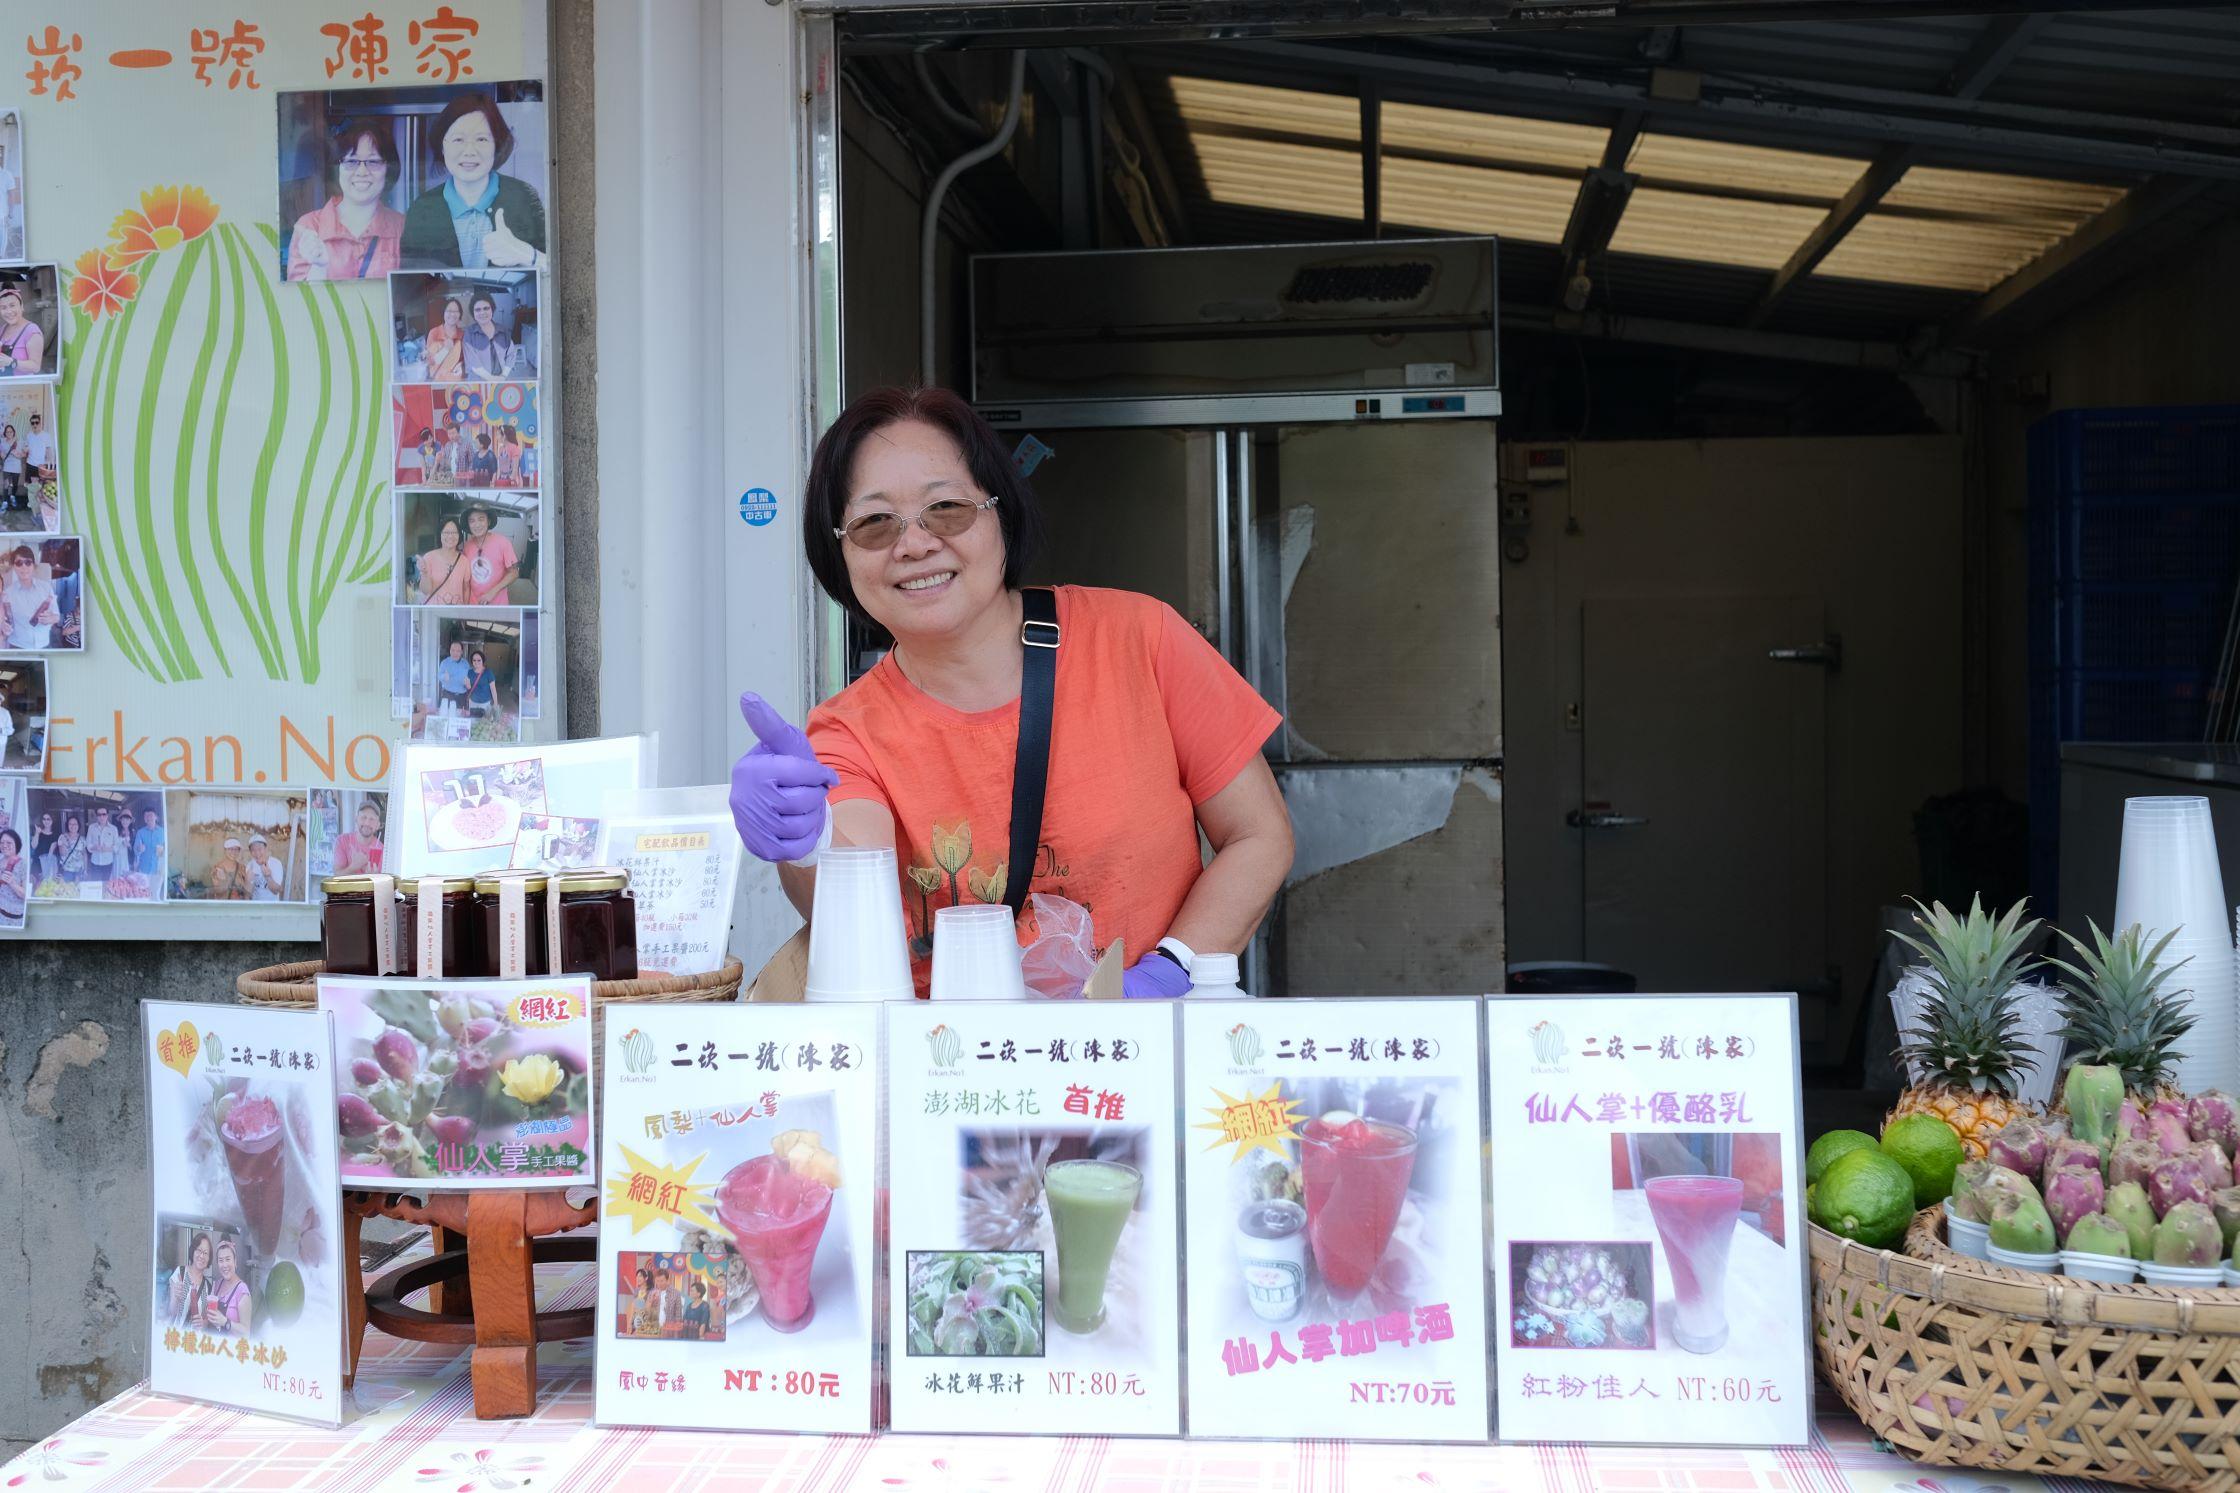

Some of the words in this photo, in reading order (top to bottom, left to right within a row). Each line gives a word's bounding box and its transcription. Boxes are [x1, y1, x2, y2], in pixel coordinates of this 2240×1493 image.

[320, 6, 479, 84] 陳家
[44, 709, 408, 784] Erkan.No
[520, 996, 570, 1022] 網紅
[160, 1033, 196, 1062] 首推
[924, 1087, 1041, 1116] 澎湖冰花
[1062, 1083, 1126, 1121] 首推
[1524, 1090, 1754, 1125] 仙人掌+優酪乳
[1221, 1097, 1294, 1143] 網紅
[434, 1141, 530, 1173] 仙人掌
[530, 1154, 579, 1168] 手工果醬
[625, 1171, 690, 1215] 網紅
[1221, 1302, 1455, 1377] 仙人掌加啤酒
[924, 1373, 1025, 1395] 冰花鮮果汁
[1349, 1381, 1456, 1406] NT:70元
[1521, 1373, 1661, 1400] 紅粉佳人
